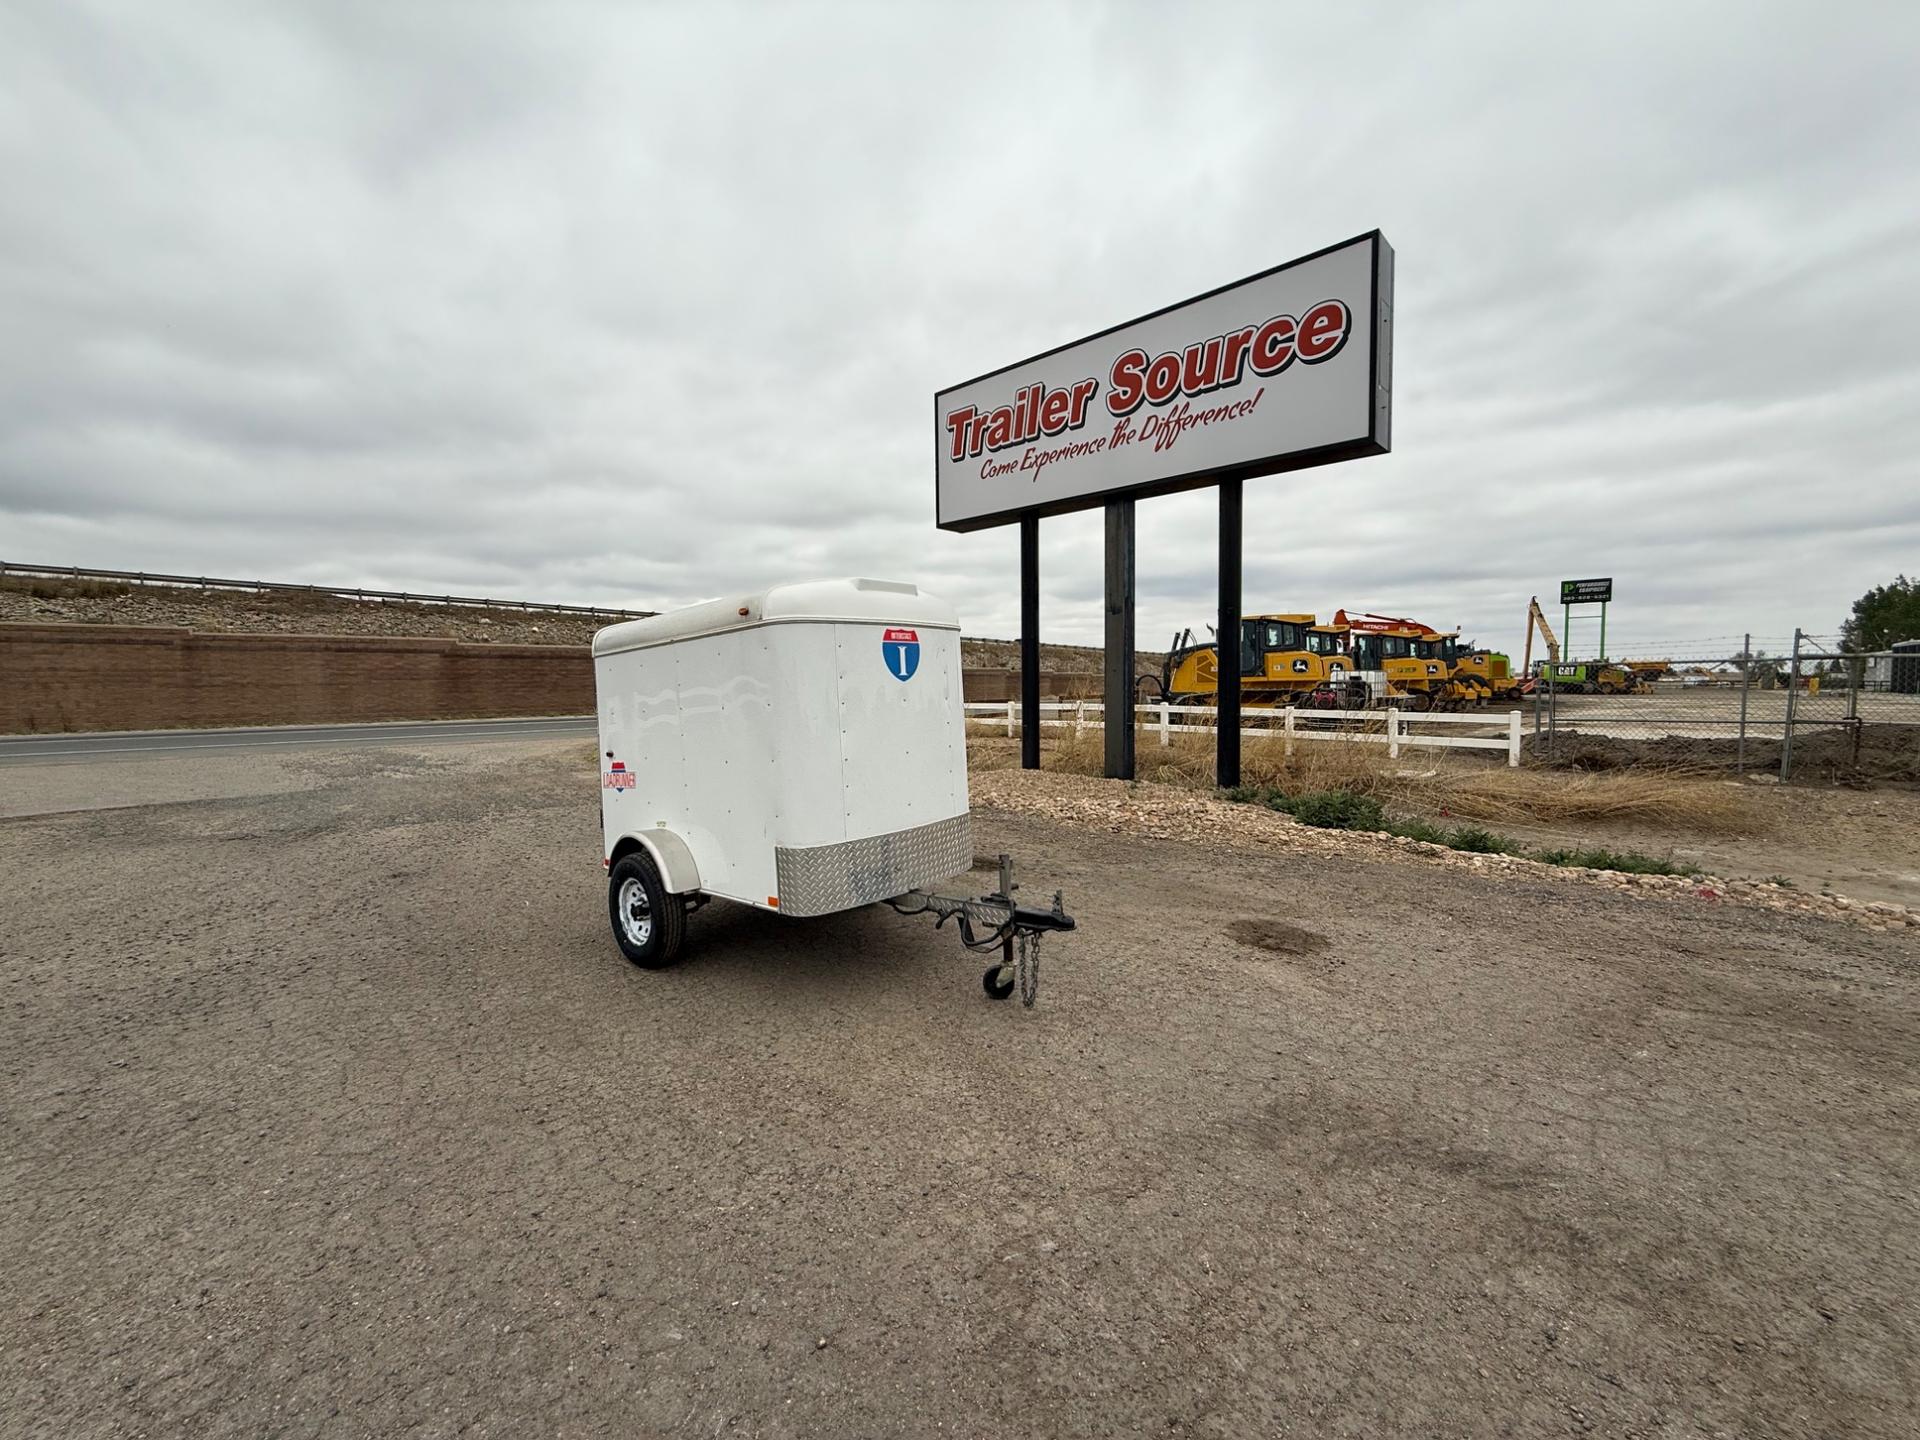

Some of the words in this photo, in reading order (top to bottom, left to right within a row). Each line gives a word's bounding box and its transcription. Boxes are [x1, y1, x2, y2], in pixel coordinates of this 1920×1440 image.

[946, 378, 1098, 462] Trailer
[1106, 299, 1351, 416] Source
[981, 452, 1018, 479] Come
[1019, 437, 1106, 482] Experience
[1109, 418, 1136, 450] the
[1139, 388, 1264, 453] Difference!
[1558, 666, 1575, 675] CAT
